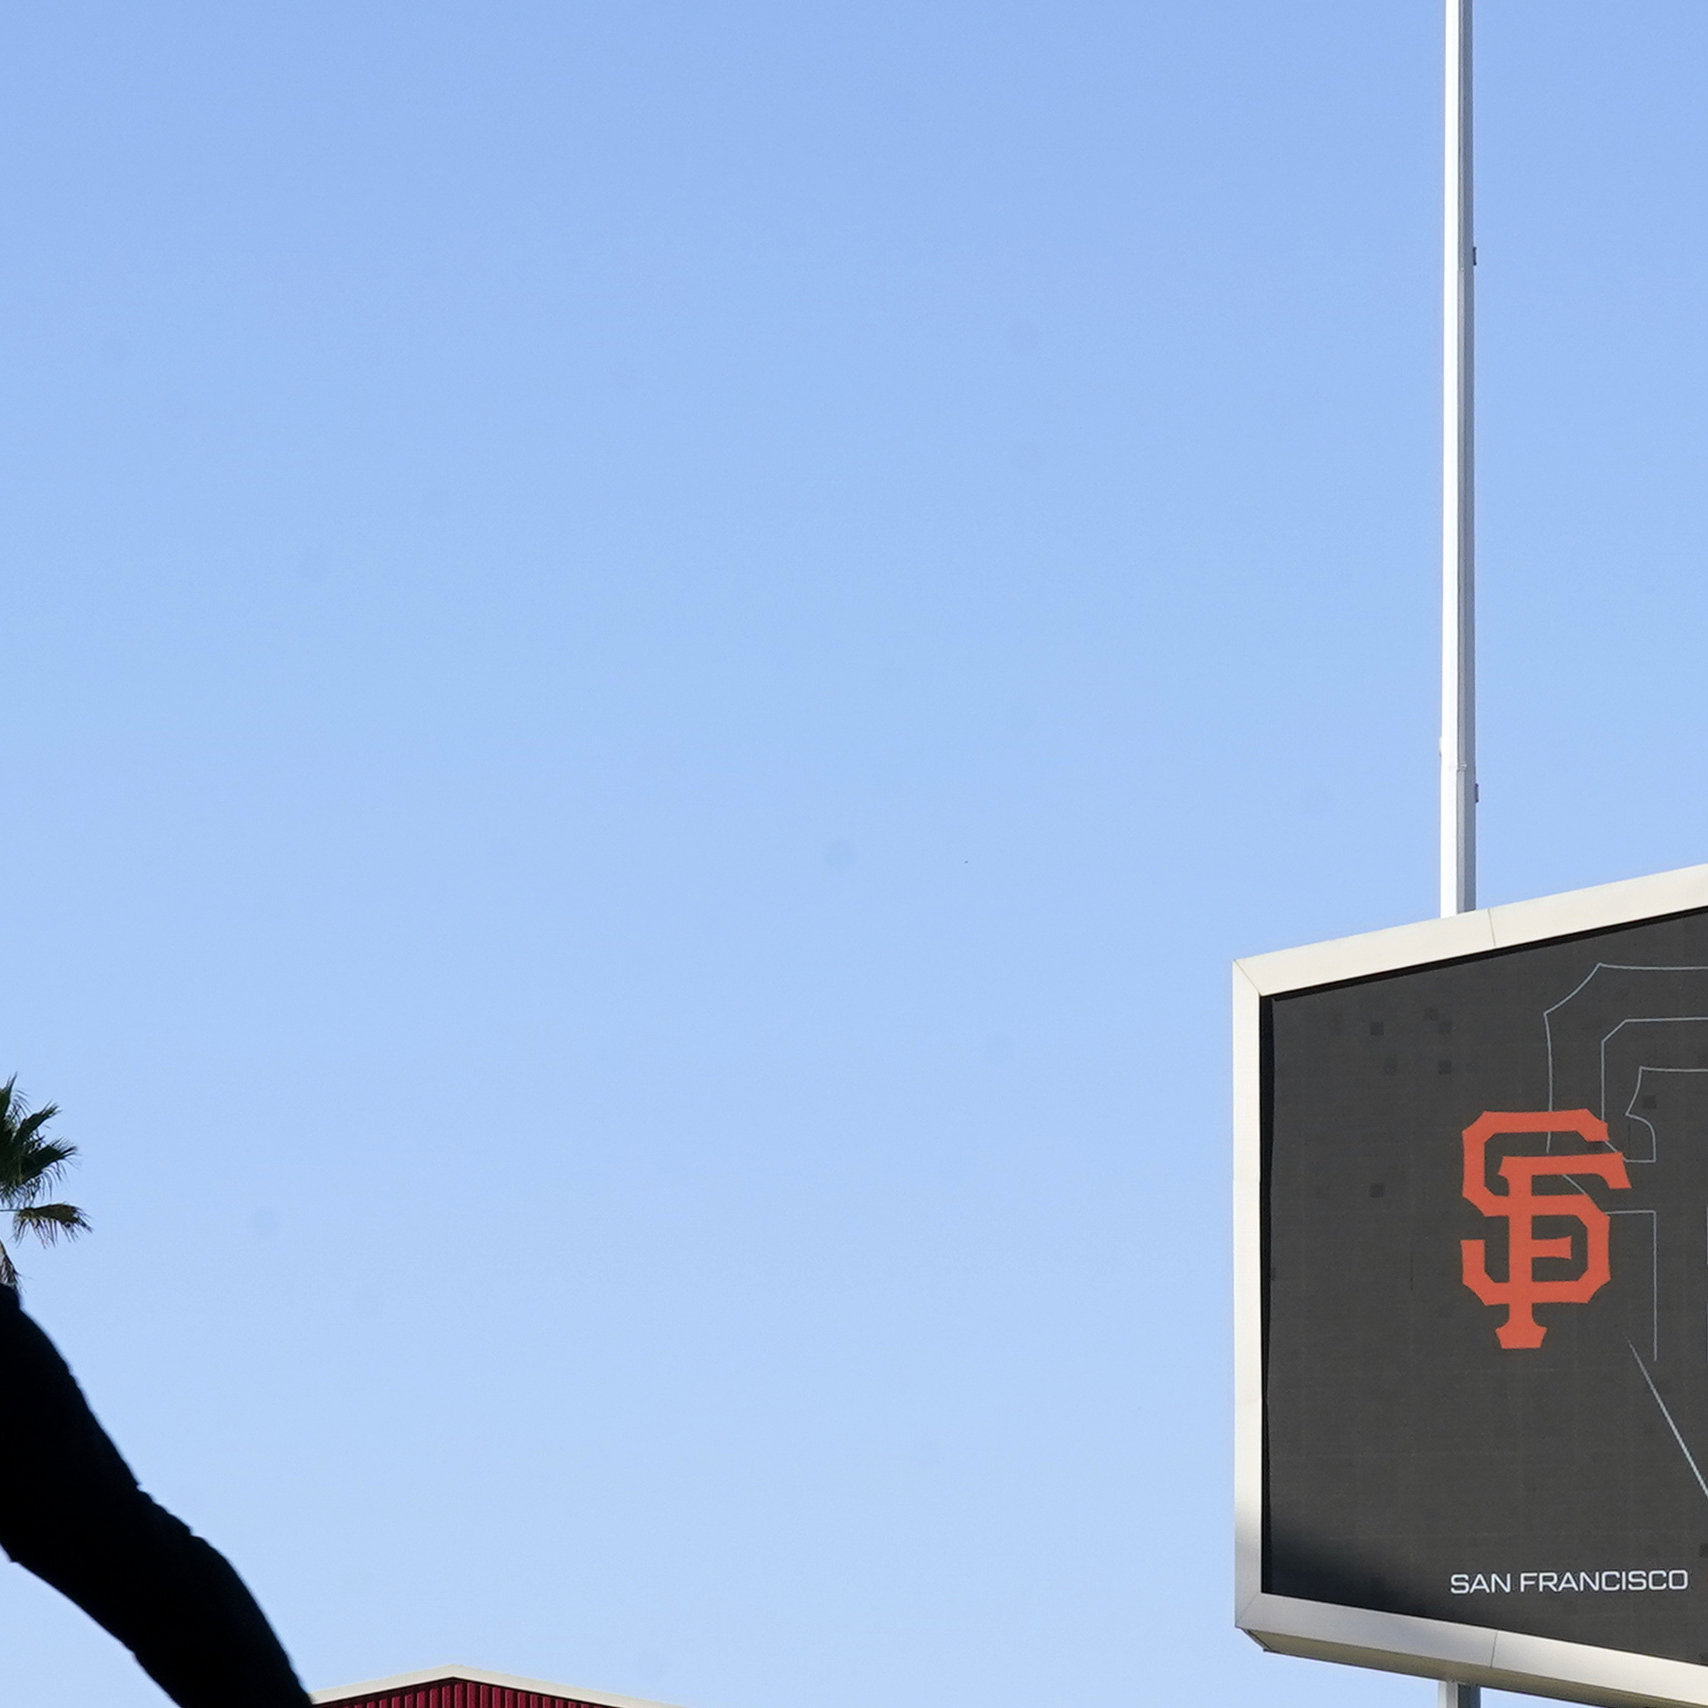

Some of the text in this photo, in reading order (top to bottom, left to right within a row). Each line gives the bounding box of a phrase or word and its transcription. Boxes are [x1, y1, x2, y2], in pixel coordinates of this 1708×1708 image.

[1460, 1108, 1631, 1350] SF
[1450, 1573, 1511, 1594] SAN
[1520, 1569, 1689, 1593] FRANCISCO
